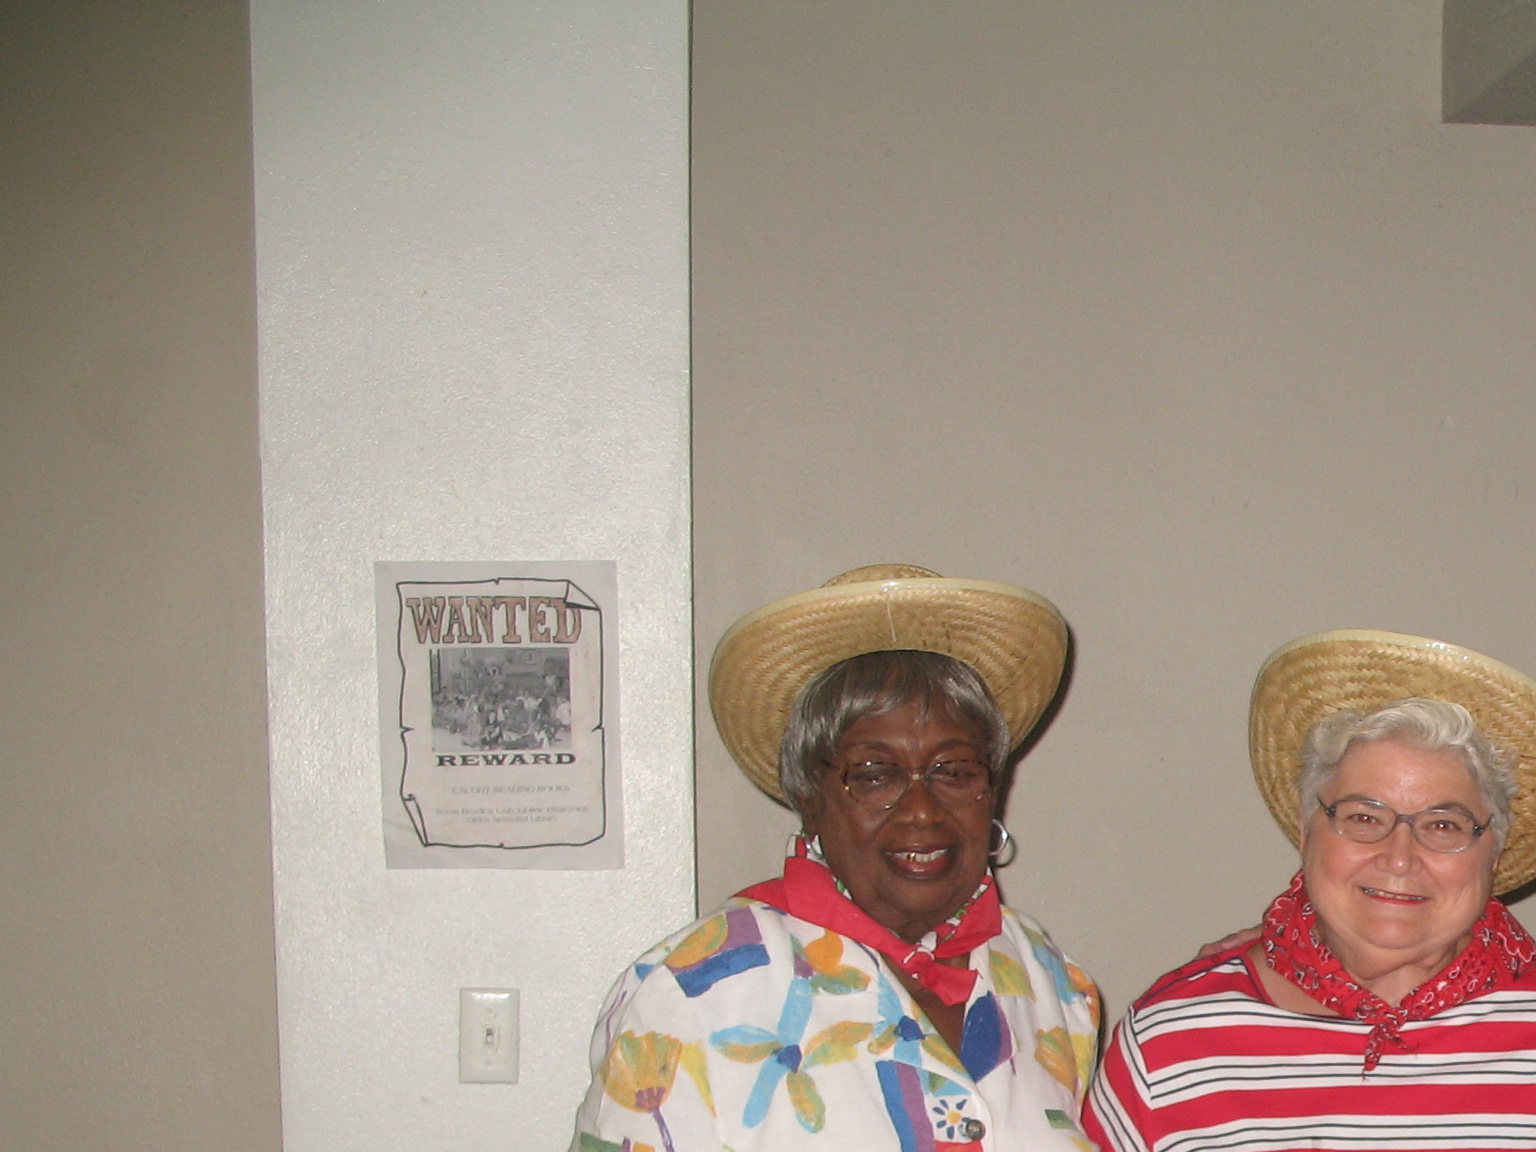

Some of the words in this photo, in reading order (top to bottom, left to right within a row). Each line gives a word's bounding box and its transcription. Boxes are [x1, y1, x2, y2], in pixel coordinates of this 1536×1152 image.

[406, 596, 582, 644] WANTED
[436, 753, 576, 767] REWARD
[493, 785, 535, 794] READING
[537, 784, 570, 793] BOOKS
